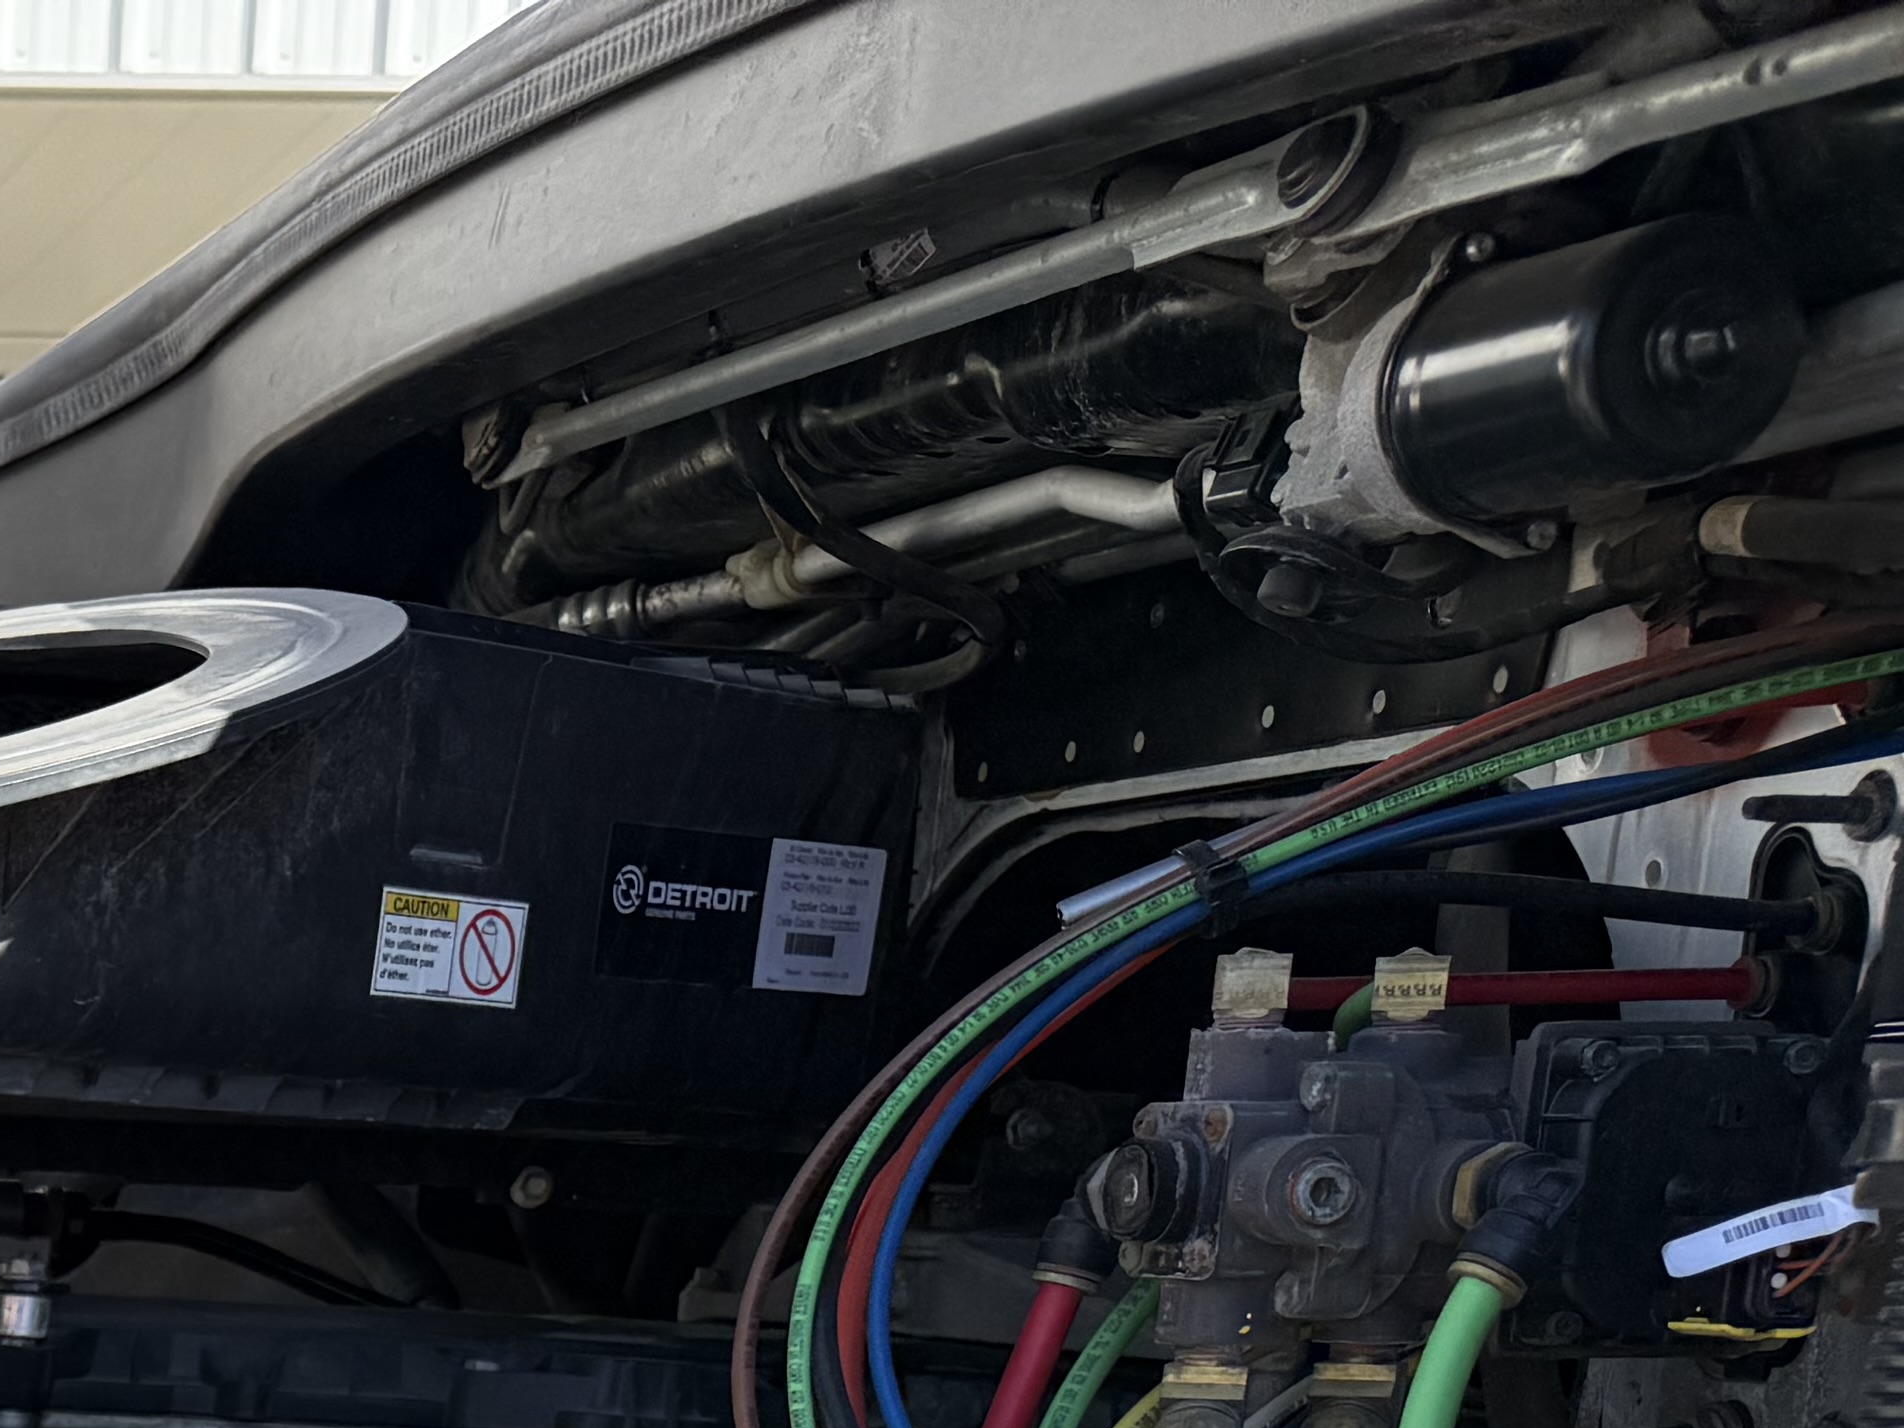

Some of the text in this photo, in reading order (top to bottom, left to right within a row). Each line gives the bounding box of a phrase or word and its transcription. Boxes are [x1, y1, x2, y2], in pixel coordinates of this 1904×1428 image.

[647, 881, 754, 912] DETROIT
[394, 897, 450, 918] CAUTION
[386, 921, 452, 940] Do not use ether.
[419, 958, 435, 969] pas
